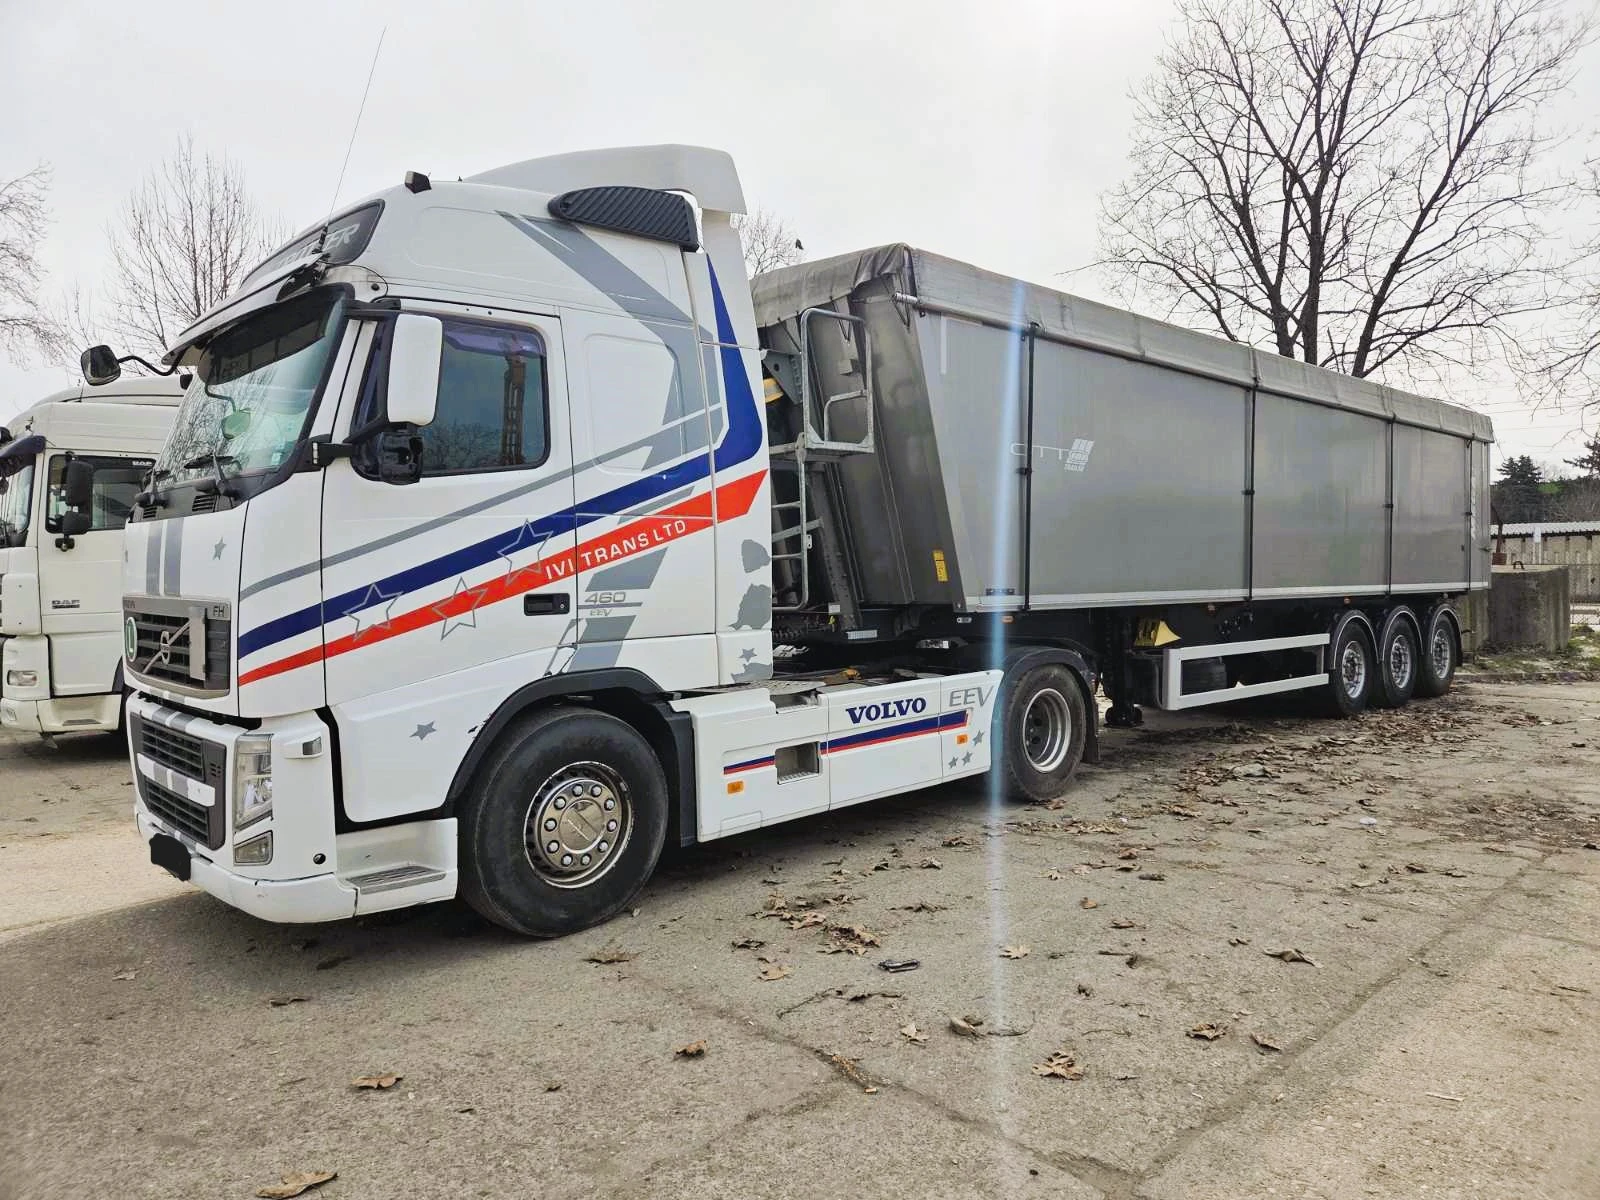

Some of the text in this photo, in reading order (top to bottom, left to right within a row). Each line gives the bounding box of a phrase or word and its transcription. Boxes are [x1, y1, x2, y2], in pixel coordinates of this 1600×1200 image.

[545, 520, 686, 580] IVI TRANS LTD
[584, 592, 627, 604] 460
[213, 605, 225, 617] FH
[590, 609, 612, 617] EEV
[949, 685, 994, 707] EEV
[845, 697, 927, 725] VOLVO
